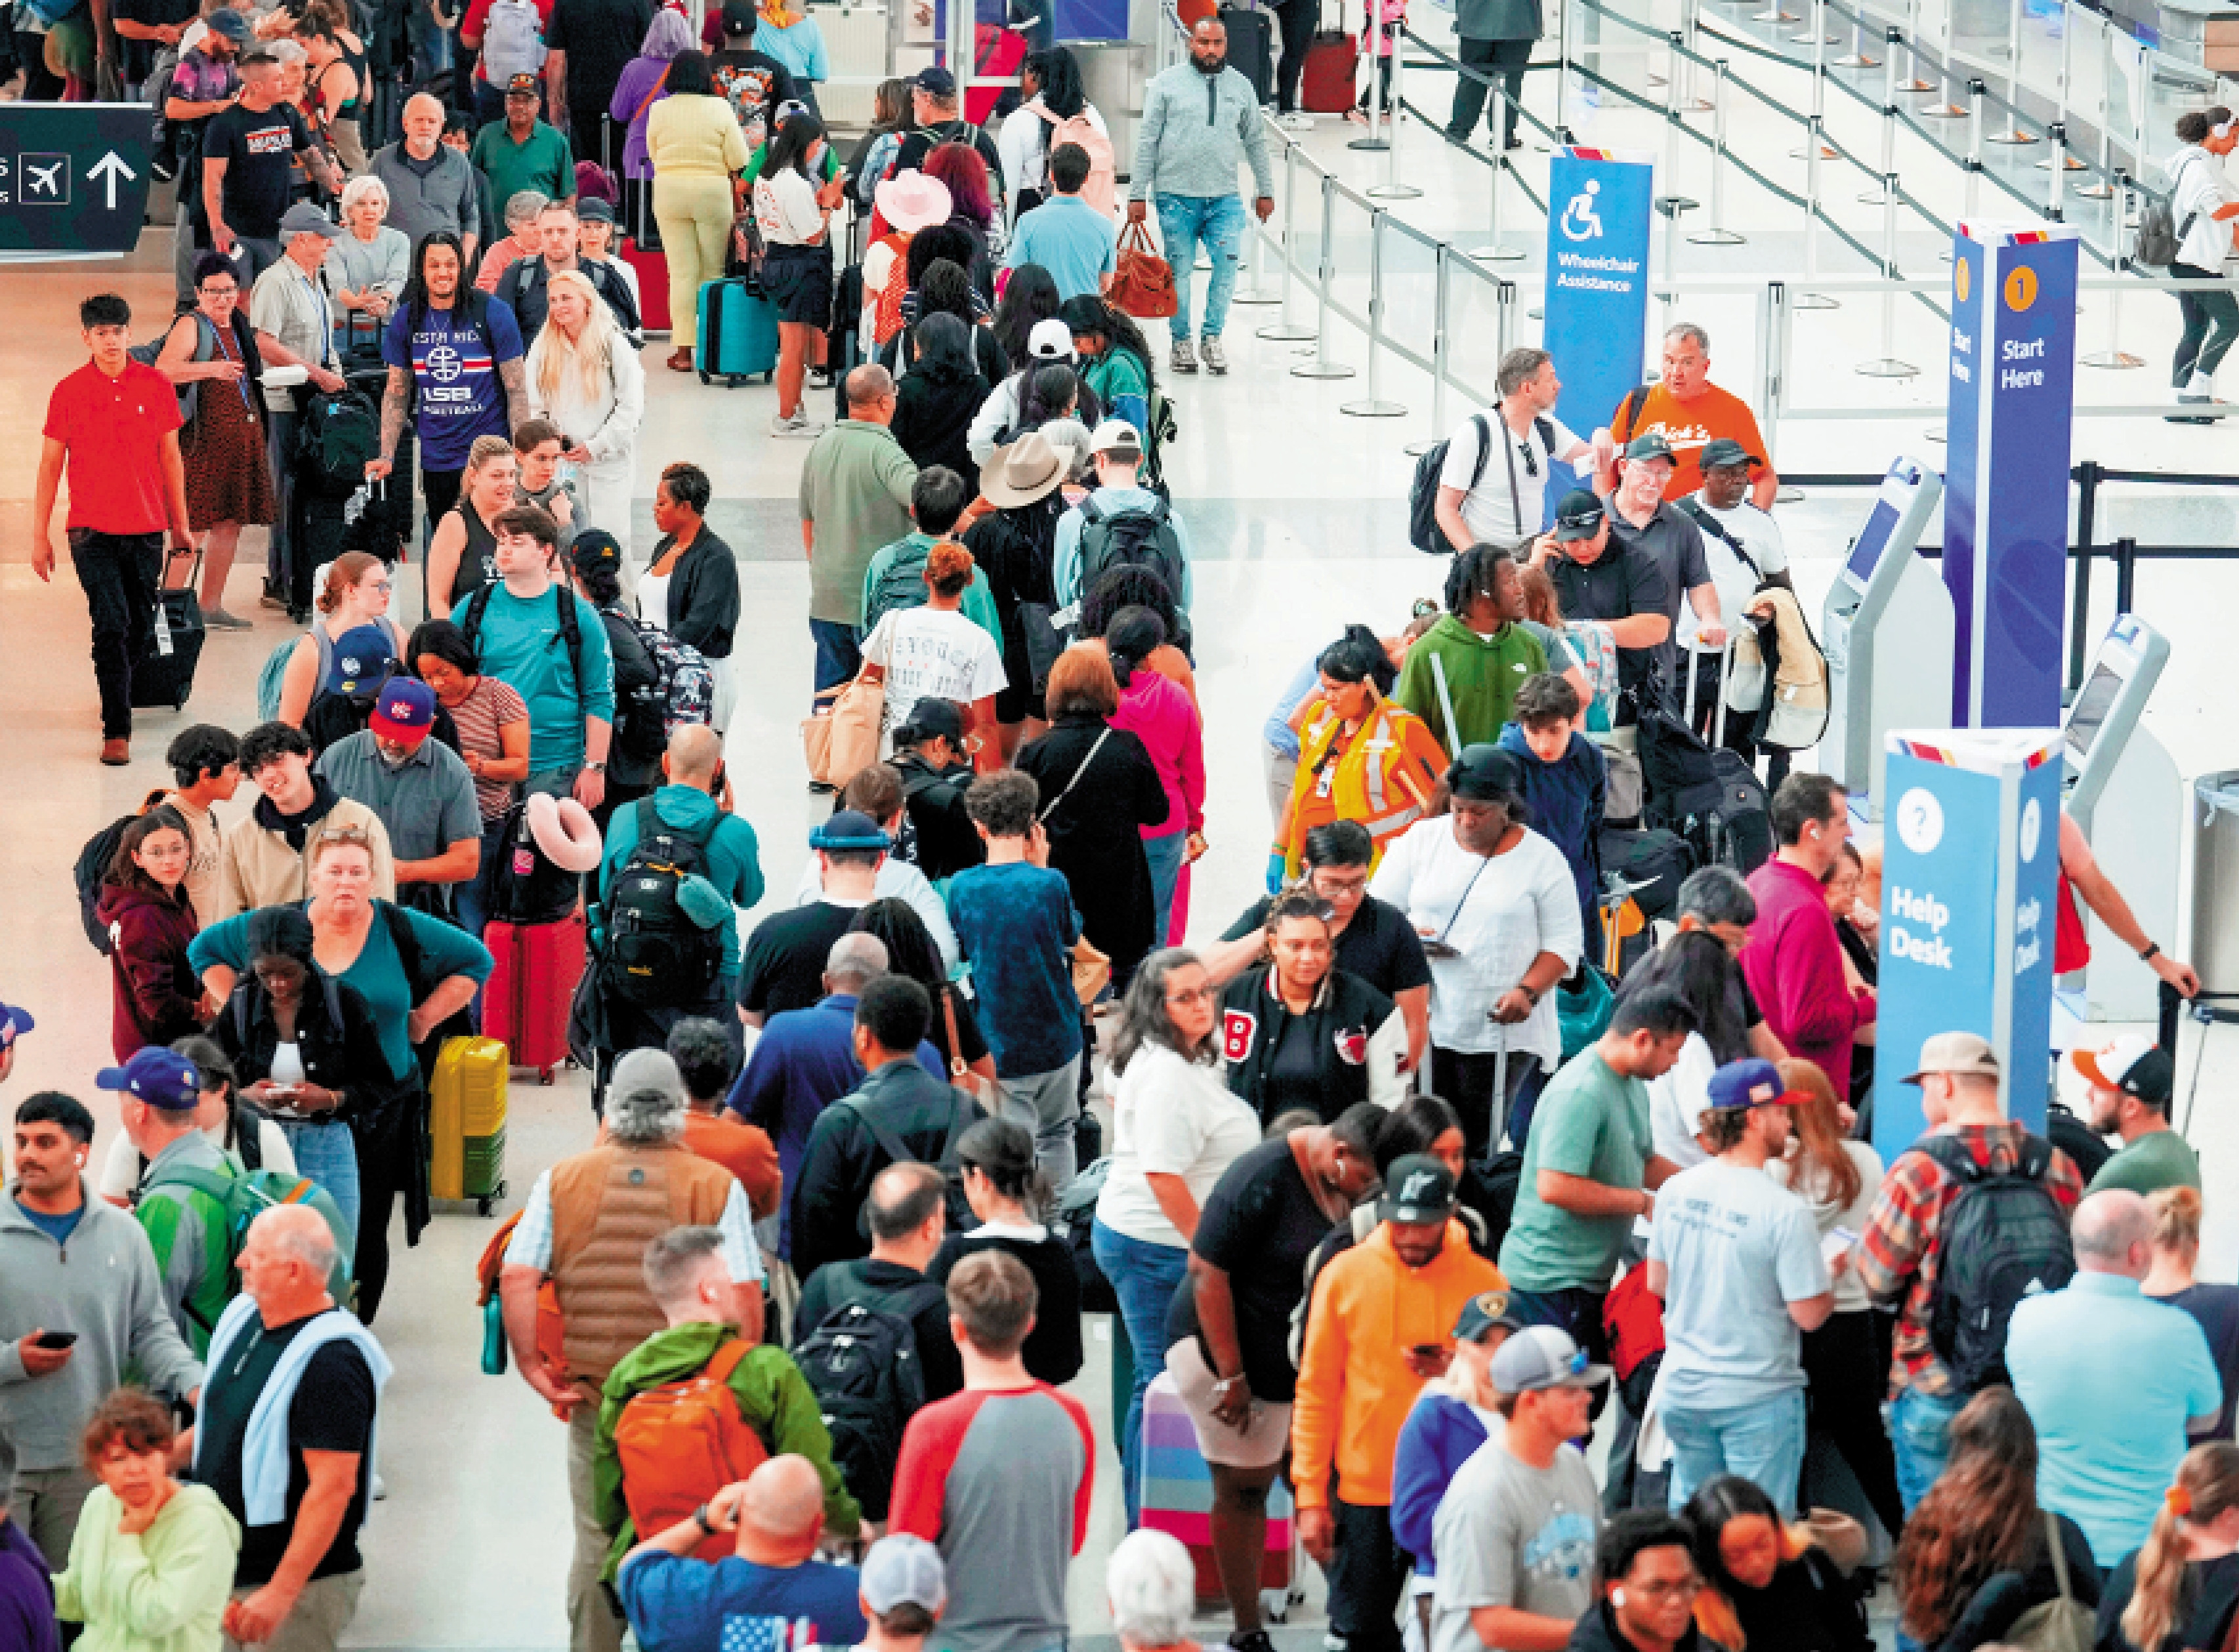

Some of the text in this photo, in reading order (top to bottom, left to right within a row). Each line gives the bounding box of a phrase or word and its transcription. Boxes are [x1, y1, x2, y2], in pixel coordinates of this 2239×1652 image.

[1558, 252, 1639, 273] Wheelchair
[1557, 273, 1631, 292] Assistance
[2016, 278, 2024, 300] 1
[2001, 337, 2045, 361] Start
[2001, 367, 2045, 390] Here
[1891, 886, 1950, 934] Help
[1889, 925, 1953, 970] Desk
[1224, 1009, 1258, 1063] B
